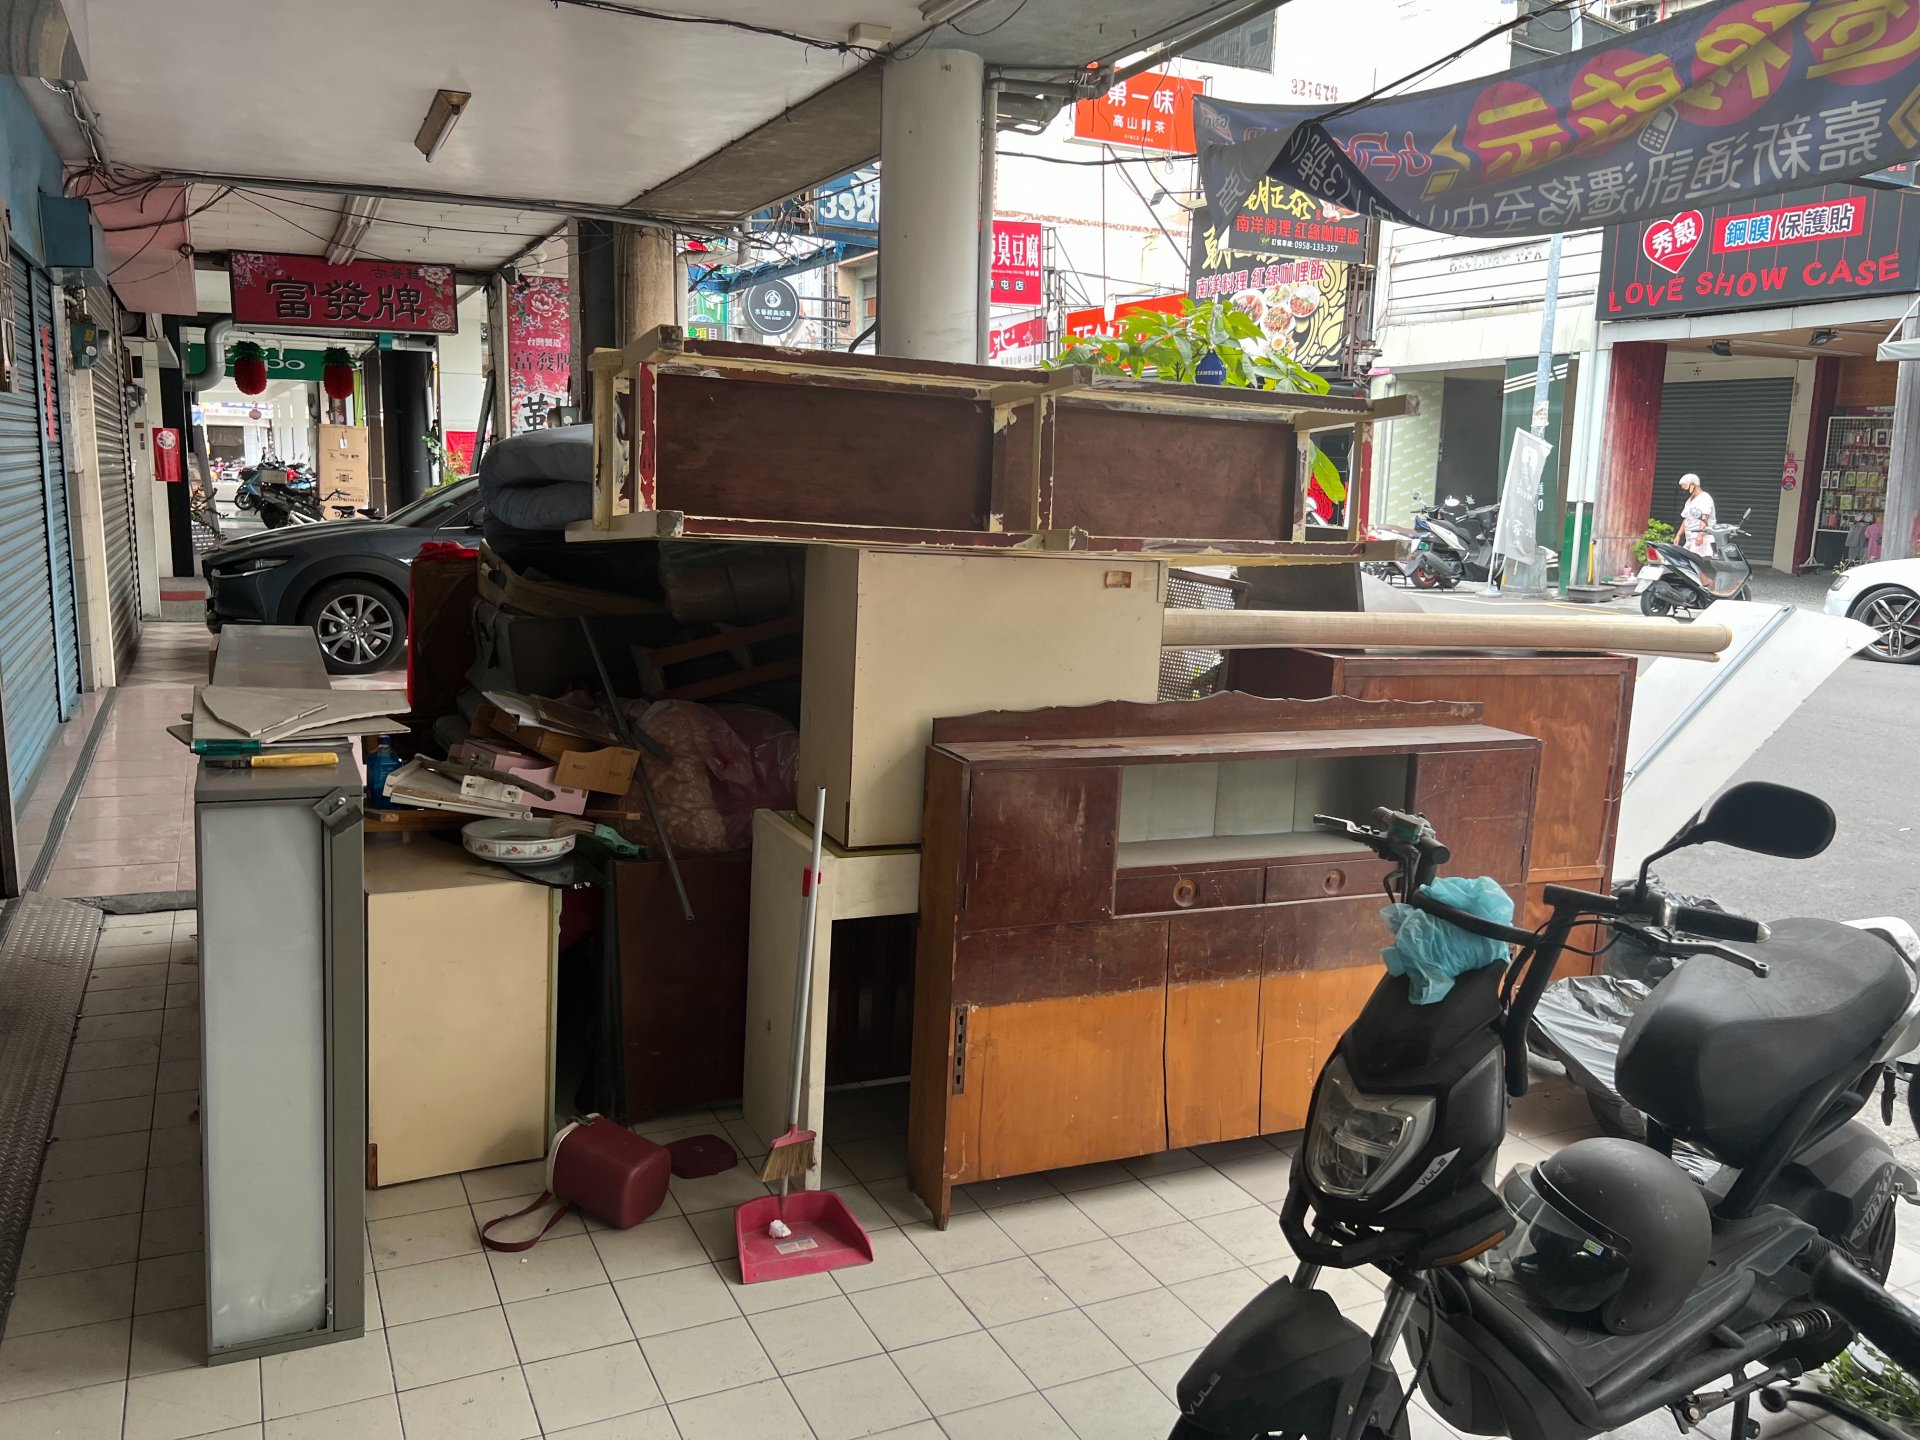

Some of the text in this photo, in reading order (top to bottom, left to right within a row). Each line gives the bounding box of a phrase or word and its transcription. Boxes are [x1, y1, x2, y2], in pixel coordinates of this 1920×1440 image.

[1107, 81, 1174, 115] 第一味
[1113, 114, 1166, 134] 高山青茶
[1235, 214, 1292, 238] 南洋料理
[1293, 222, 1360, 246] 紅綠咖哩飯
[1724, 203, 1856, 247] 鋼膜/保護貼
[1294, 241, 1339, 253] 0958-133-357
[1195, 259, 1326, 300] 南洋料理 紅綠咖哩飯
[1608, 252, 1901, 312] LOVE SHOW CASE
[265, 275, 428, 325] 富發牌
[526, 336, 562, 348] 台灣製造
[1195, 369, 1224, 377] SAMSUNG
